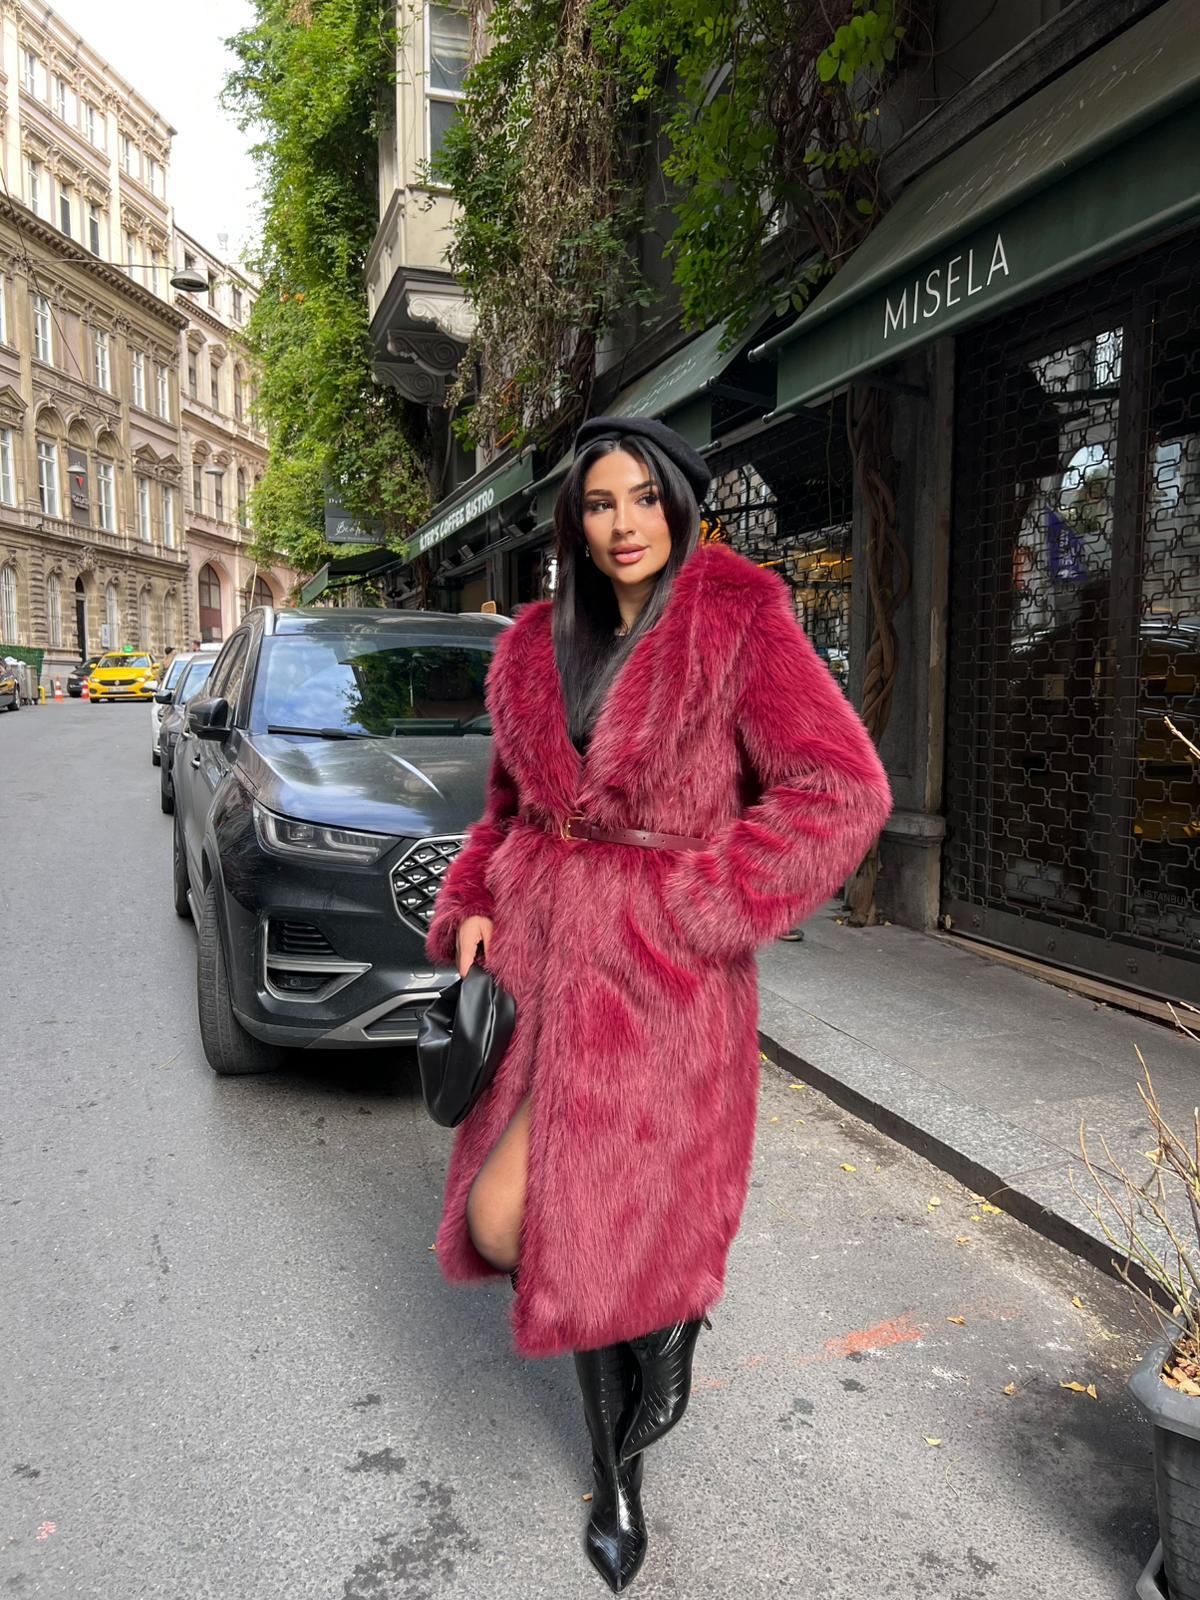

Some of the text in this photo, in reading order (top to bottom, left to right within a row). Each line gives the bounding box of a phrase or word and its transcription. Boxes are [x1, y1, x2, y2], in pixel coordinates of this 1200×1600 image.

[883, 233, 1009, 339] MISELA
[440, 507, 465, 538] COFFEE
[465, 488, 495, 522] BISTRO
